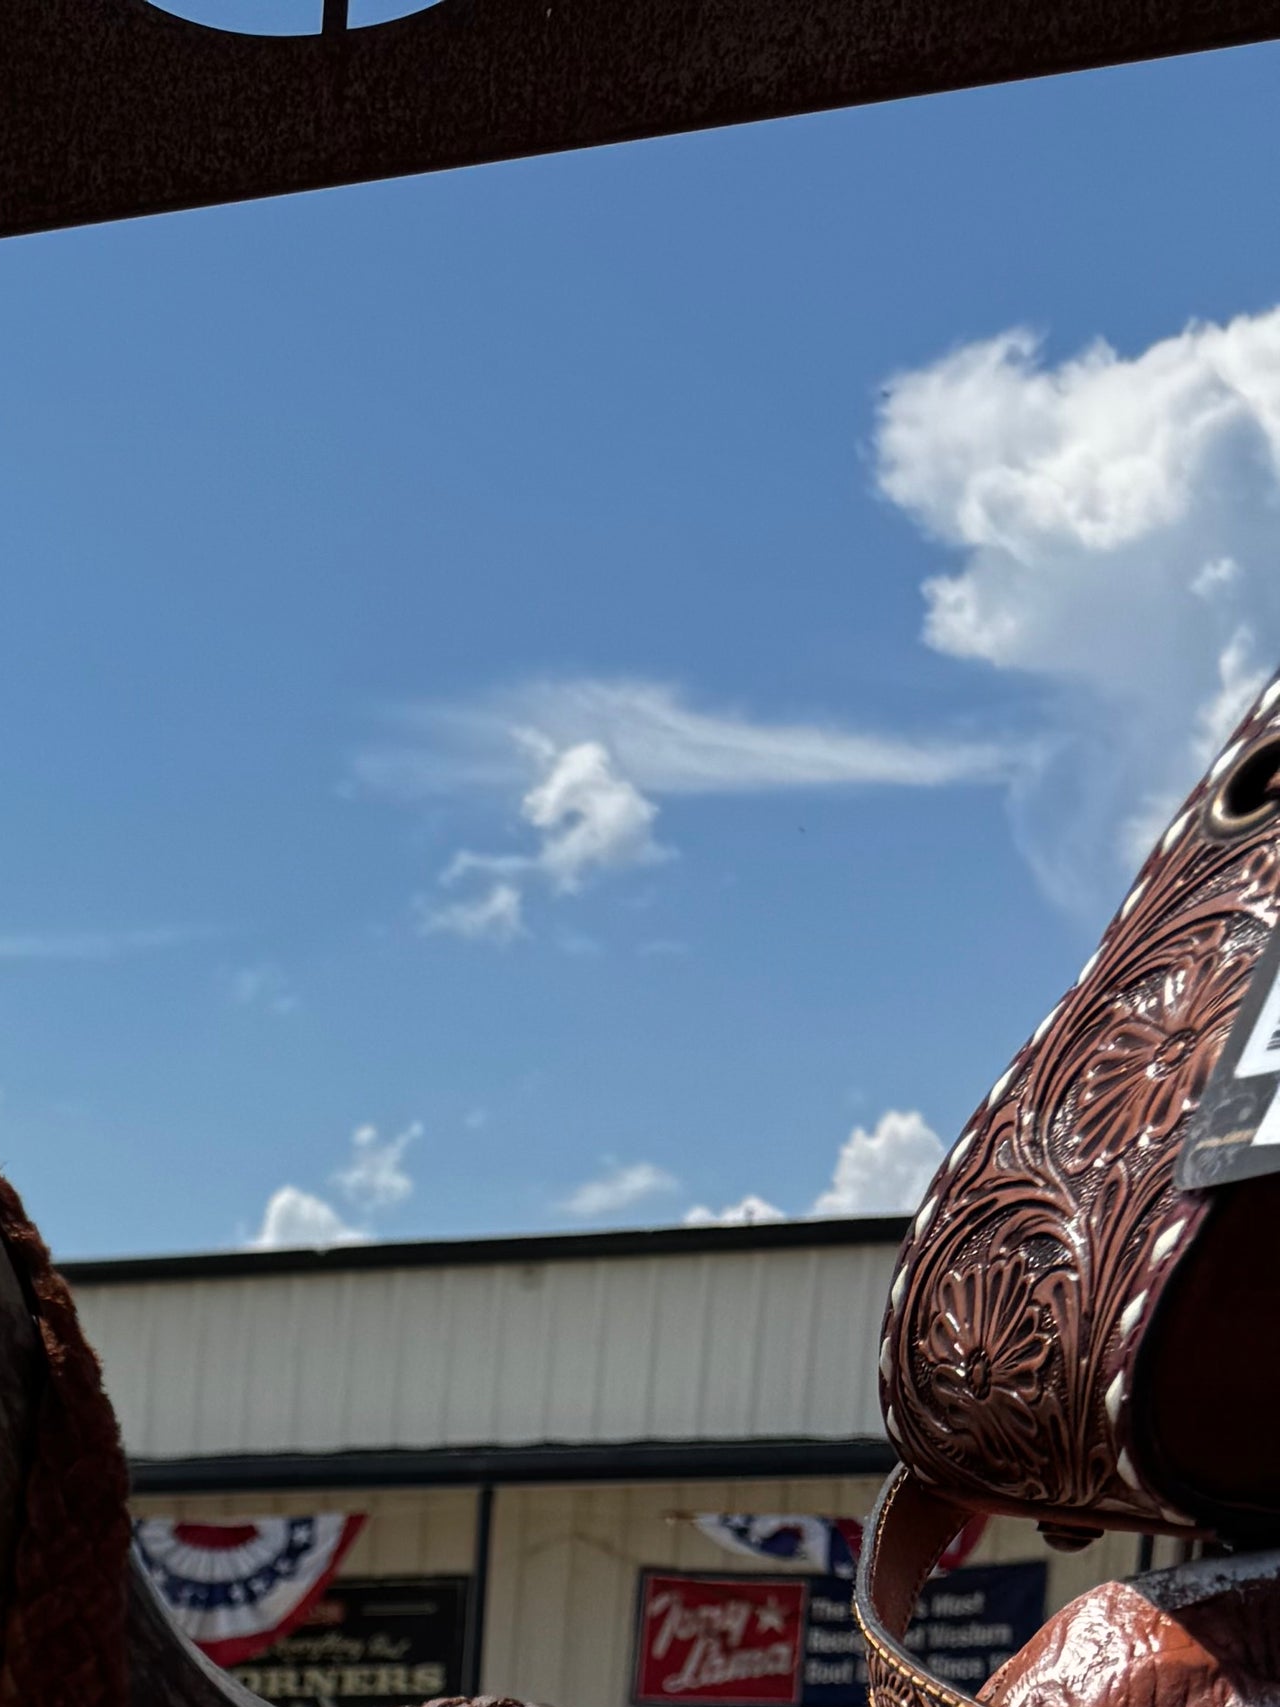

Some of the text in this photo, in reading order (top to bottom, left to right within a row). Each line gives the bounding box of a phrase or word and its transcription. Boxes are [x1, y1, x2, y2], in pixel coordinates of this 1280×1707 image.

[648, 1591, 752, 1660] Tony
[235, 1661, 447, 1698] ORNERS
[662, 1635, 791, 1694] Lama
